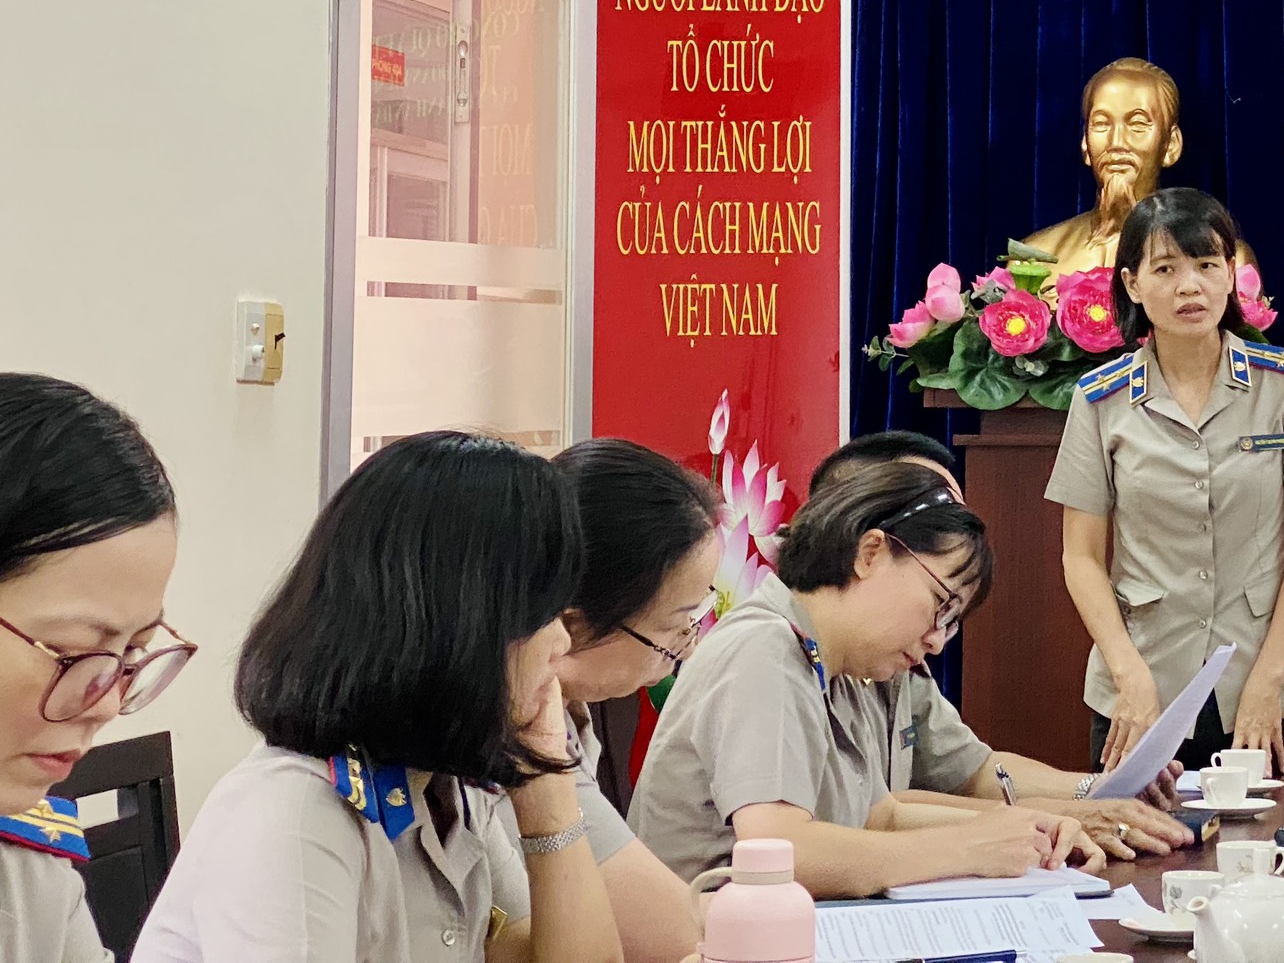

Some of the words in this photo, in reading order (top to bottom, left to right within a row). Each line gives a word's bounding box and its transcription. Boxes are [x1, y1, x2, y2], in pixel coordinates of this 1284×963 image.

[667, 23, 700, 92] TỔ
[705, 24, 774, 93] CHỨC
[627, 119, 675, 185] MỌI
[681, 104, 766, 173] THẮNG
[771, 115, 812, 184] LỢI
[616, 185, 669, 255] CỦA
[673, 184, 741, 255] CÁCH
[747, 201, 821, 266] MẠNG
[660, 273, 716, 348] VIỆT
[720, 283, 779, 336] NAM
